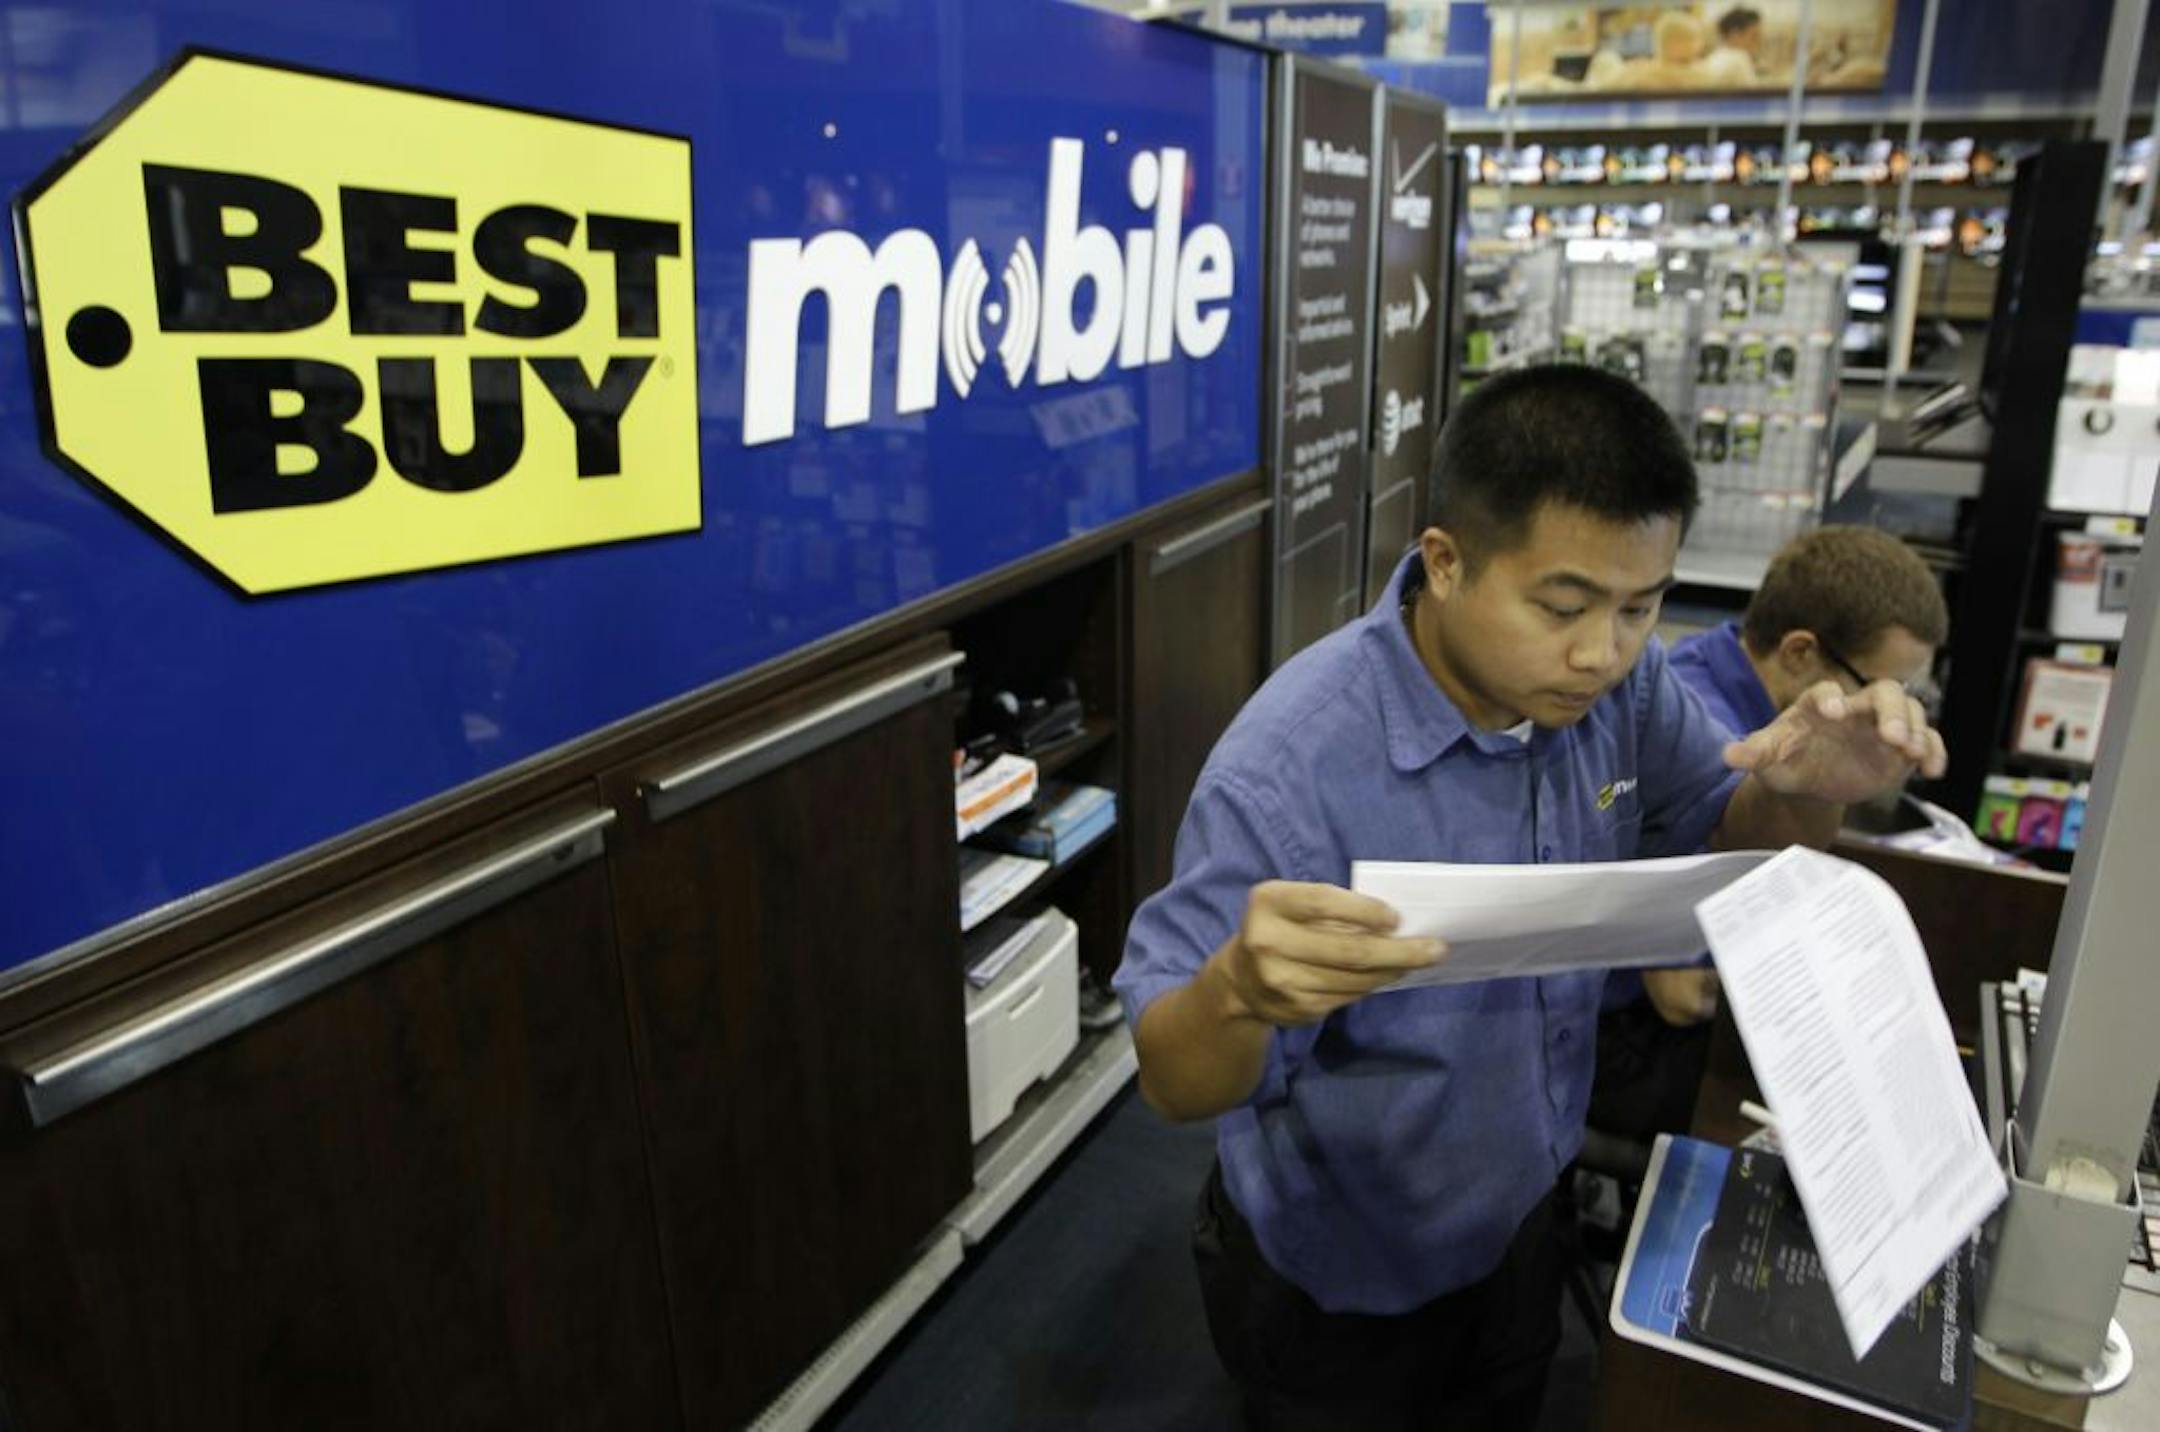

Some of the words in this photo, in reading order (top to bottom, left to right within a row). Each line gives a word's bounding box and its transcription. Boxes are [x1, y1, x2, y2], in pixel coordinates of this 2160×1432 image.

[140, 160, 681, 340] BEST
[742, 137, 1233, 447] mobile
[196, 354, 656, 516] BUY
